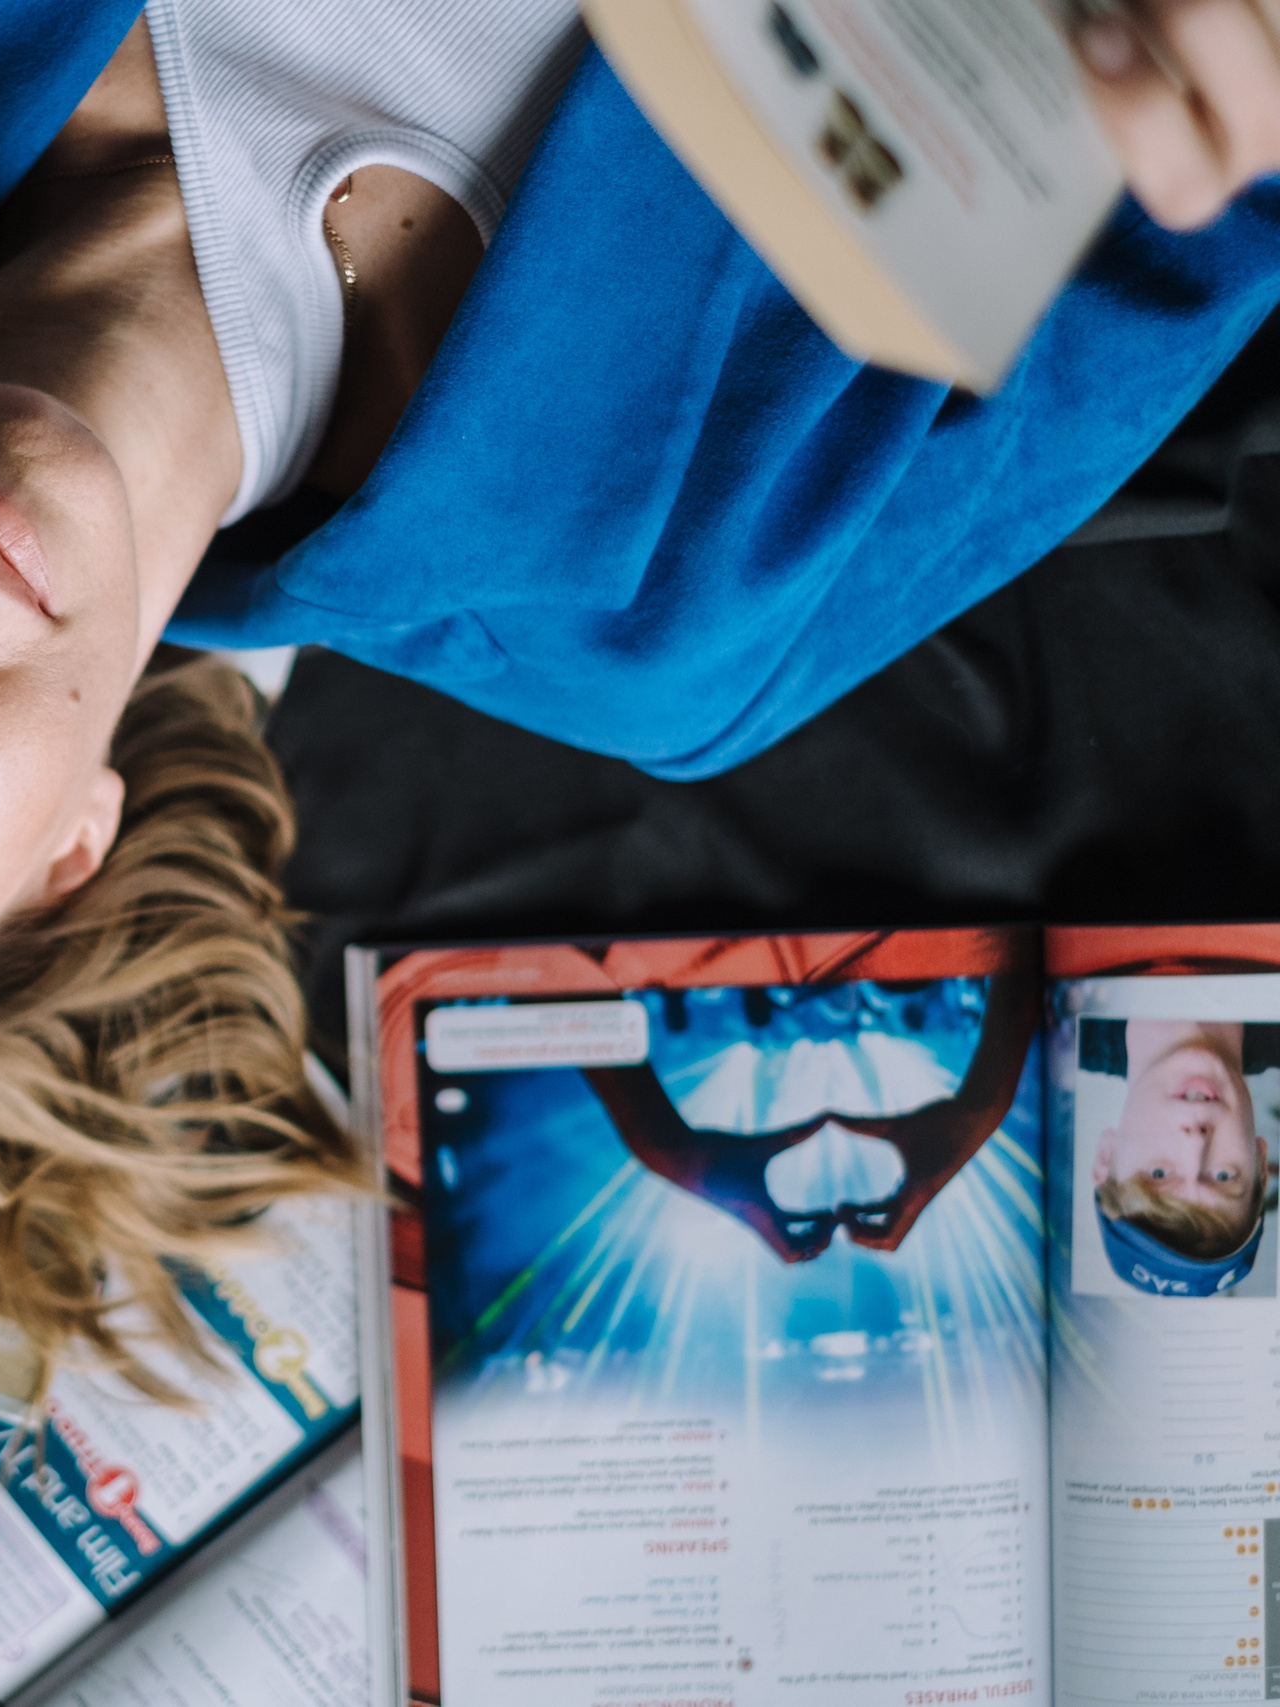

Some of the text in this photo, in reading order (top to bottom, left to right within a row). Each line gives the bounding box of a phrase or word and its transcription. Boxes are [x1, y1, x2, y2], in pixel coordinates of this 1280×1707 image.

[257, 1332, 303, 1376] 2
[15, 1459, 94, 1542] and
[65, 1519, 144, 1603] Film
[904, 1679, 1032, 1704] USEFUL PHRASES
